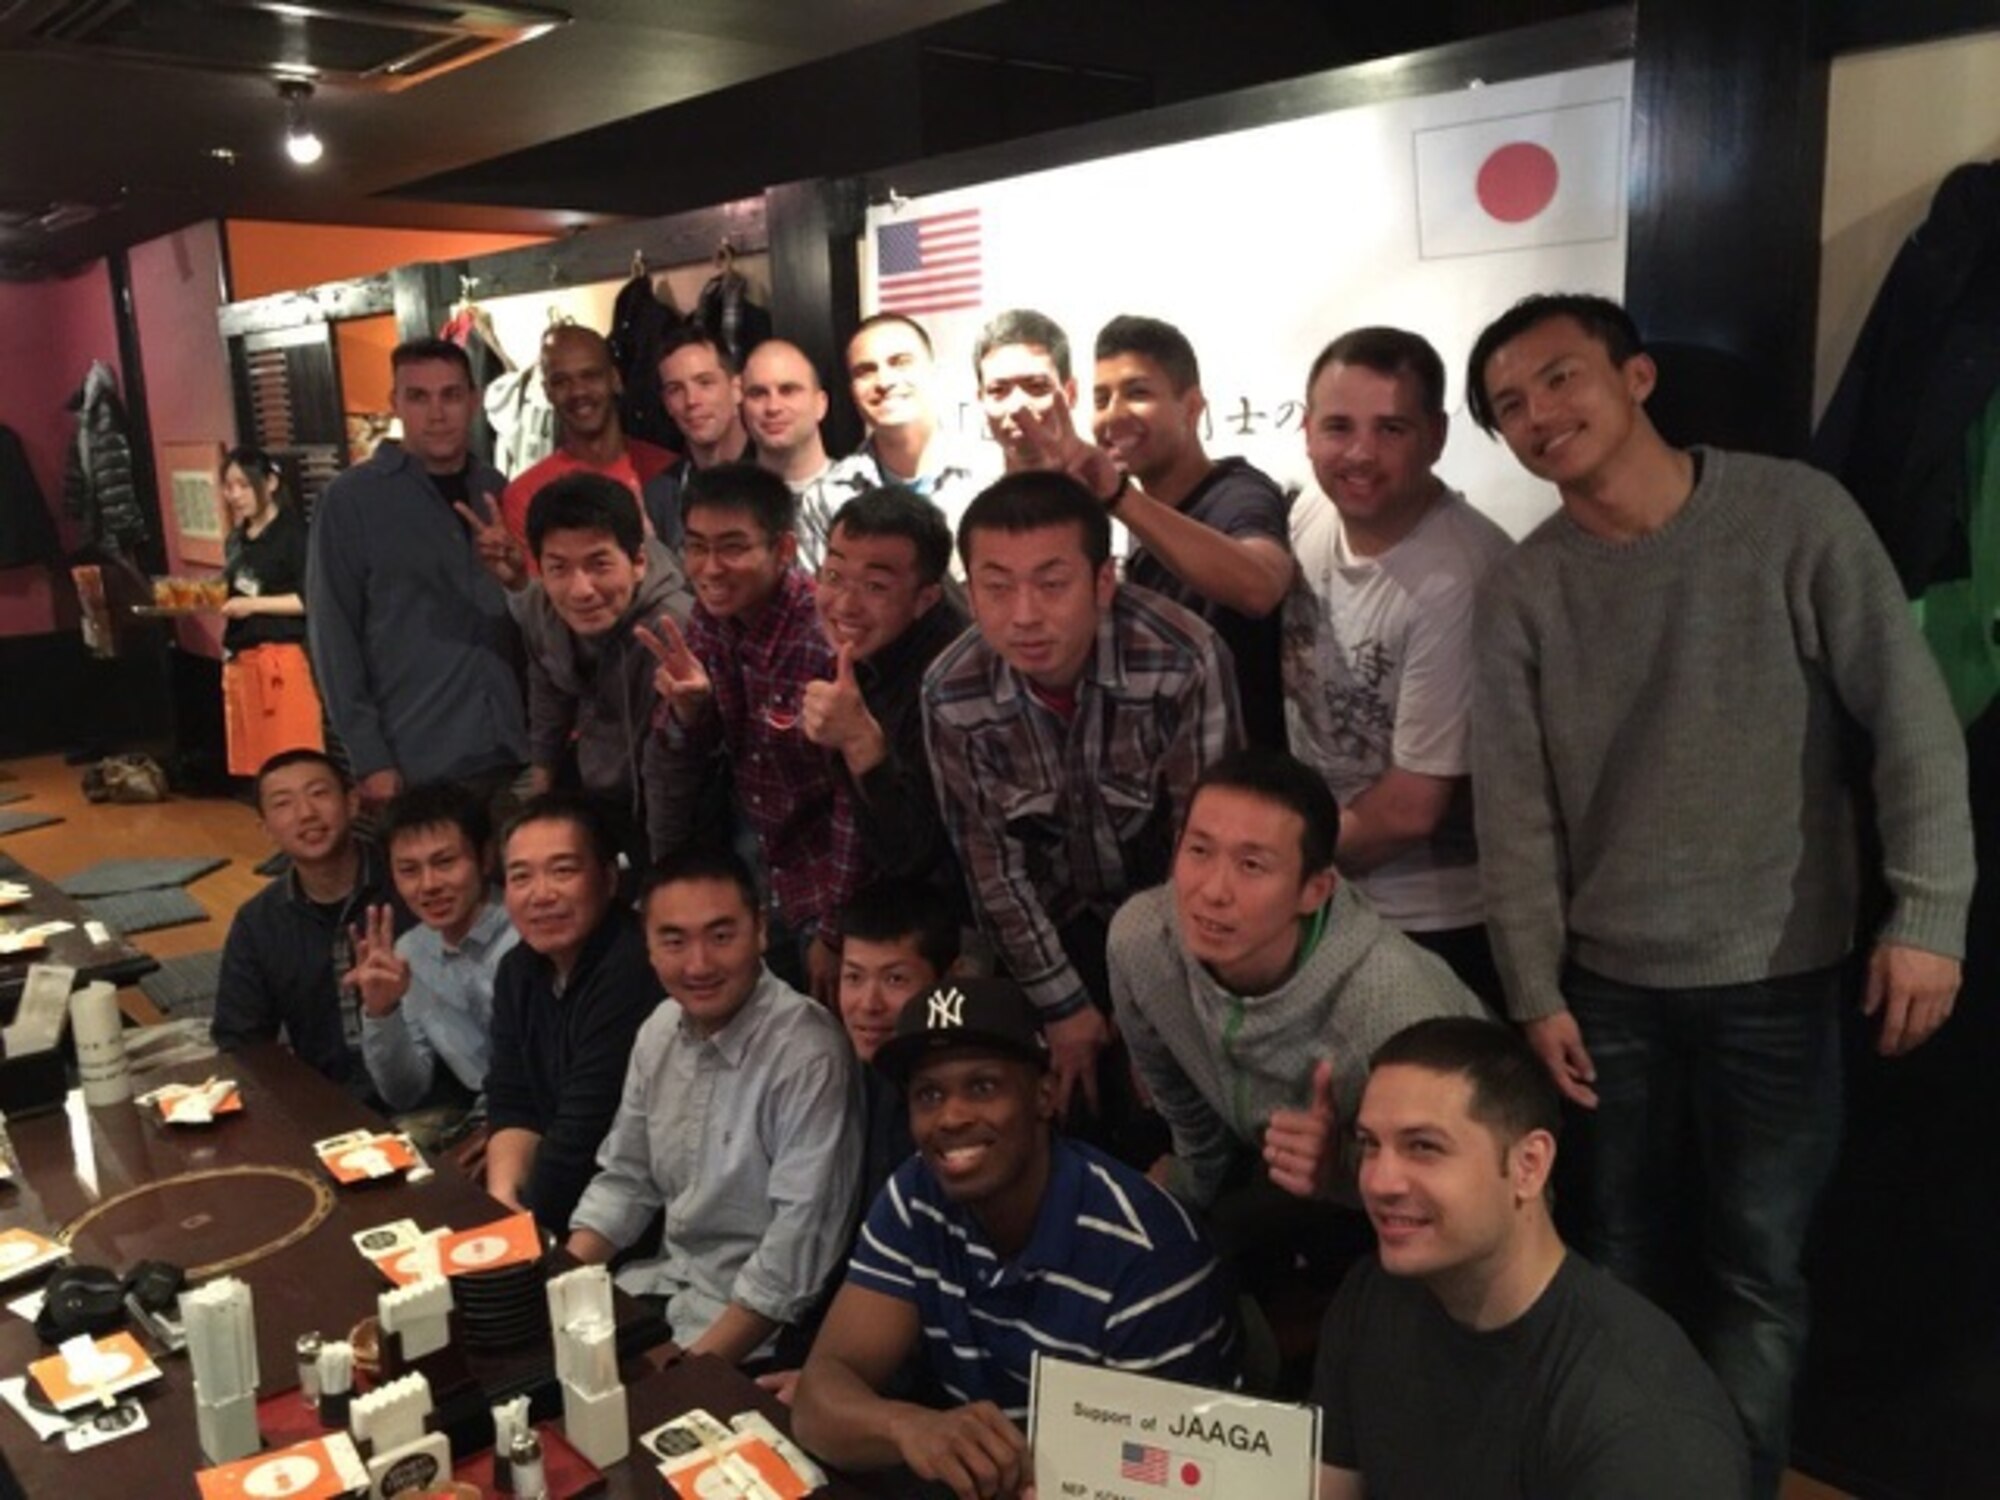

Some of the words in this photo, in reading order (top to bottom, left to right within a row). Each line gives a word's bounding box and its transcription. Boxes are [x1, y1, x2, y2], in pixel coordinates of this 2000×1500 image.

[927, 986, 966, 1029] NY
[1074, 1402, 1132, 1426] Support
[1140, 1417, 1157, 1430] of
[1169, 1414, 1272, 1457] JAAGA
